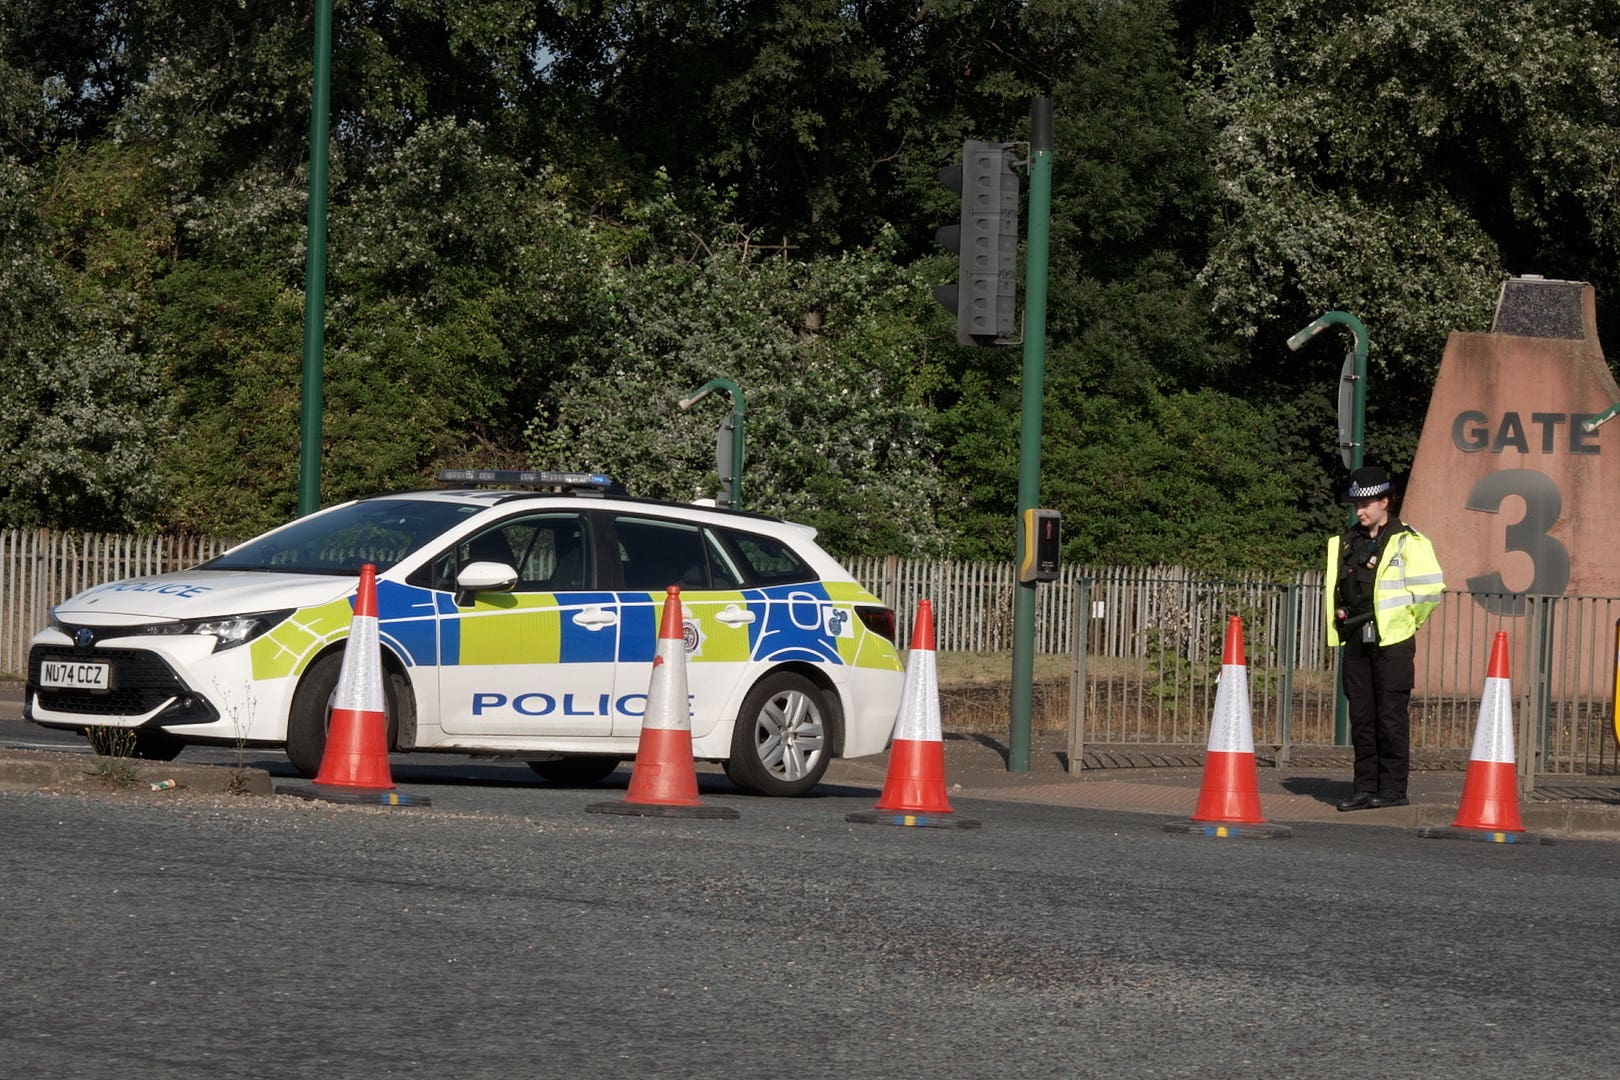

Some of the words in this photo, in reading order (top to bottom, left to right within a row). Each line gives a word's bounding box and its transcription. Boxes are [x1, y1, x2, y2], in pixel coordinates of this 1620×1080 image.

[1452, 410, 1600, 455] GATE
[1465, 468, 1570, 617] 3
[45, 664, 74, 683] NU74
[77, 665, 102, 684] CCZ
[472, 693, 695, 717] POLIC
